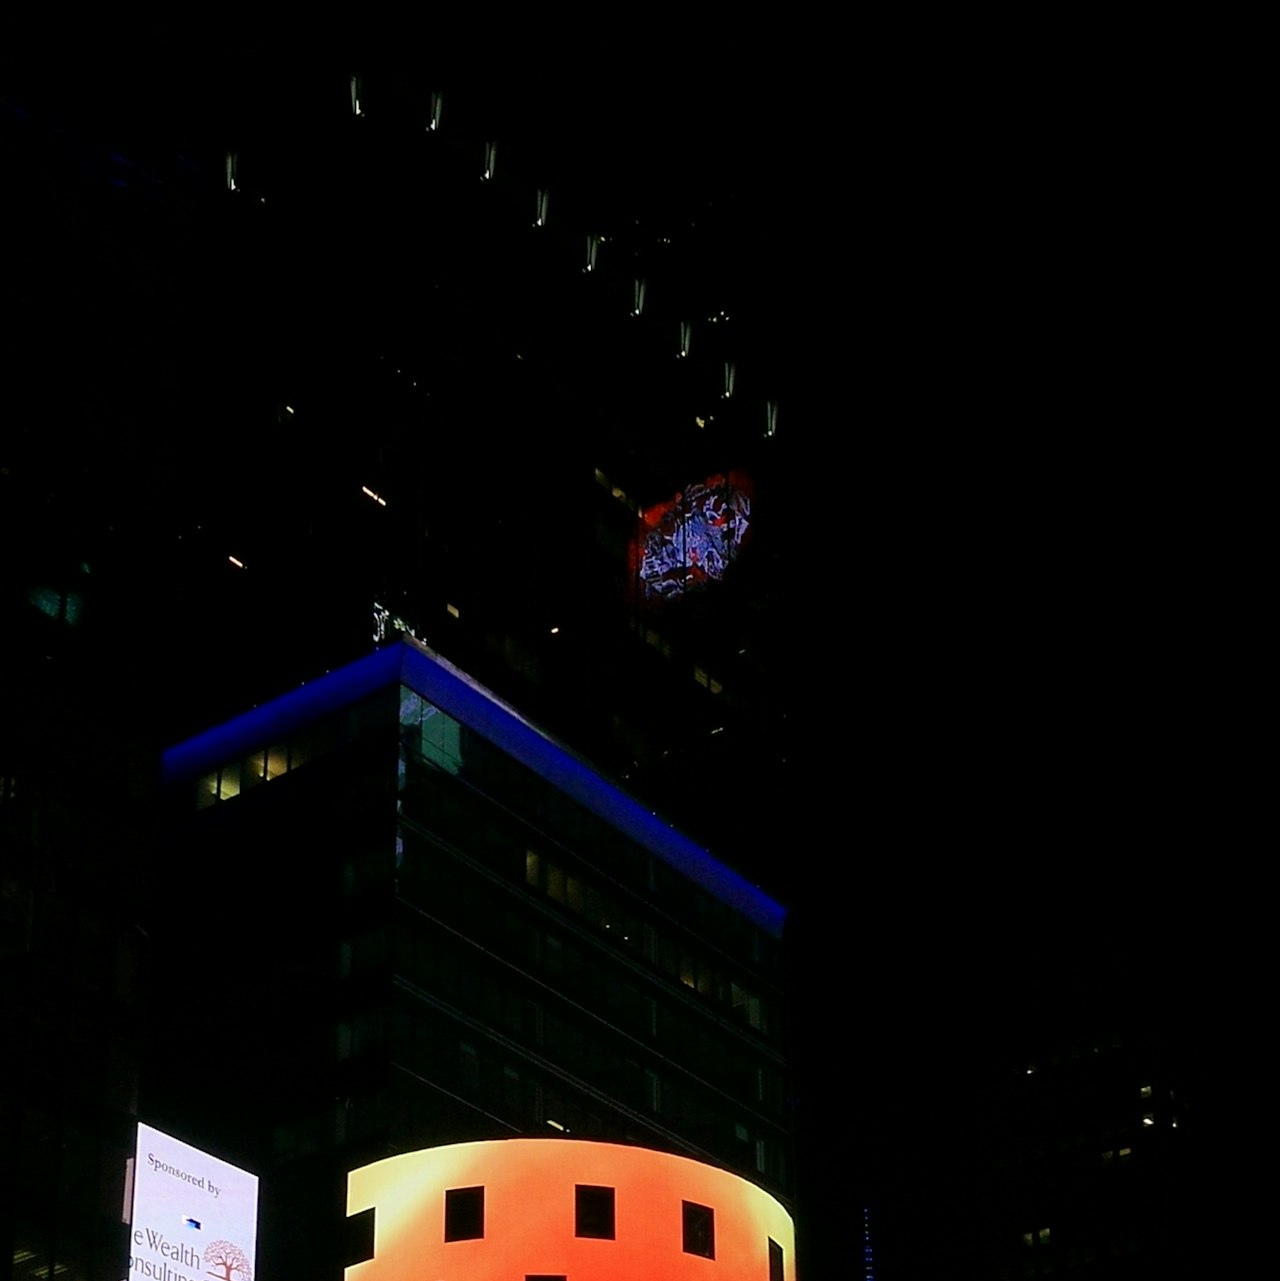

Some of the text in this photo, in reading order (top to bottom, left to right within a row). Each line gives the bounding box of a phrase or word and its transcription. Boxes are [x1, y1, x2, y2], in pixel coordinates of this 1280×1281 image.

[148, 1153, 221, 1198] Sponsored by
[146, 1228, 200, 1269] Wealth
